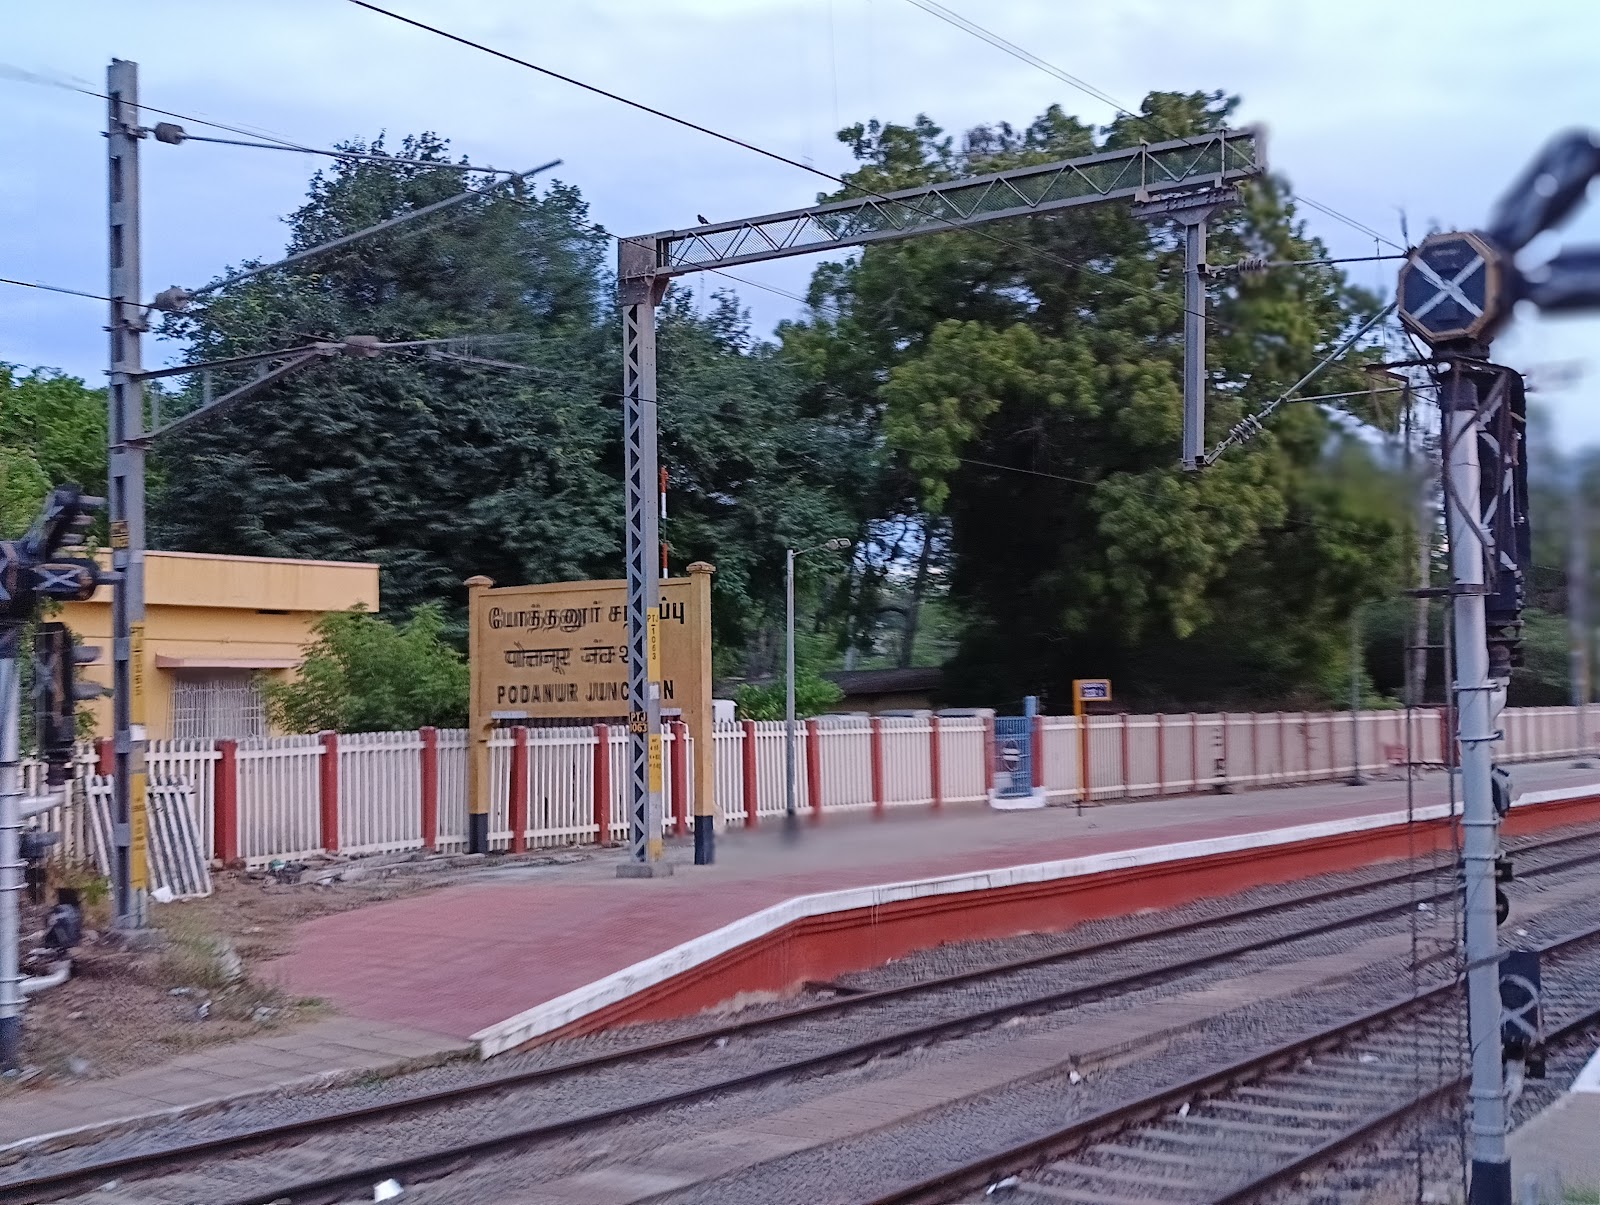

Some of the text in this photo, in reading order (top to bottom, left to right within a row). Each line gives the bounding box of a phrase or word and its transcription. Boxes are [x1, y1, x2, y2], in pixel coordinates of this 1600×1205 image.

[497, 679, 674, 705] PODANUR JUNCN
[630, 711, 647, 722] PTJ
